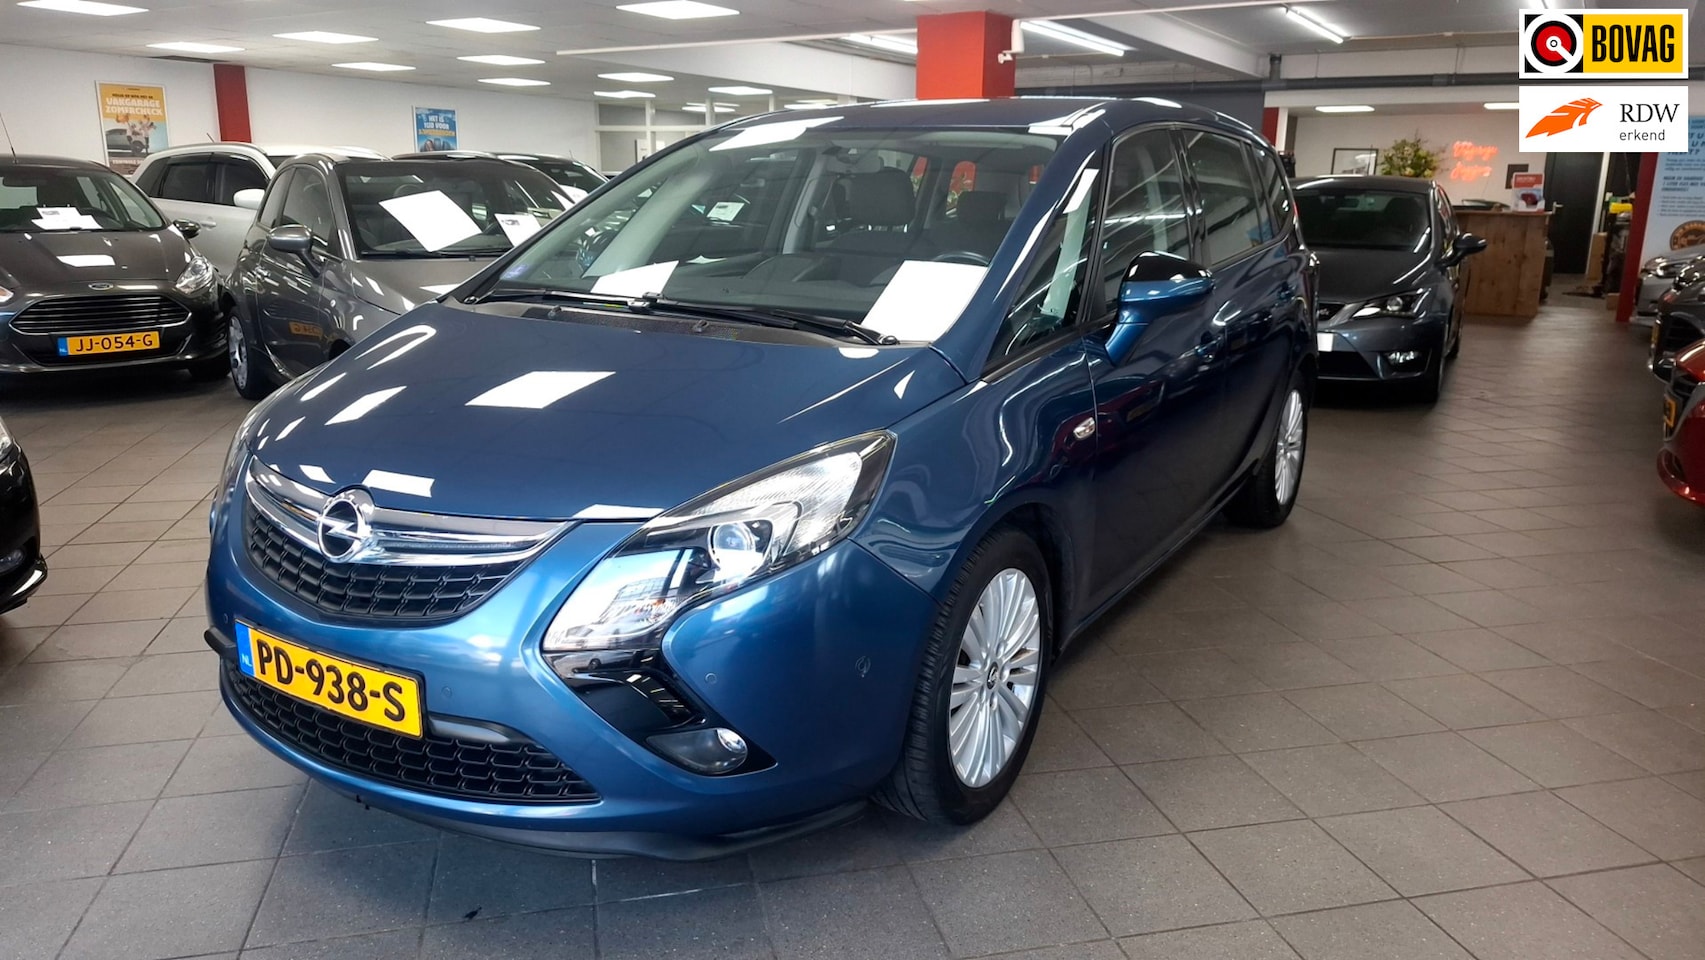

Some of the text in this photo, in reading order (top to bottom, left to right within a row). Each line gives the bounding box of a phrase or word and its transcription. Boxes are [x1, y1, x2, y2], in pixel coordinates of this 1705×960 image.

[106, 97, 161, 108] VAKGARAGE
[105, 106, 164, 116] ZOMERCHECK
[76, 334, 153, 352] JJ-054-G
[241, 653, 252, 667] NL
[256, 638, 406, 722] PD-938-S
